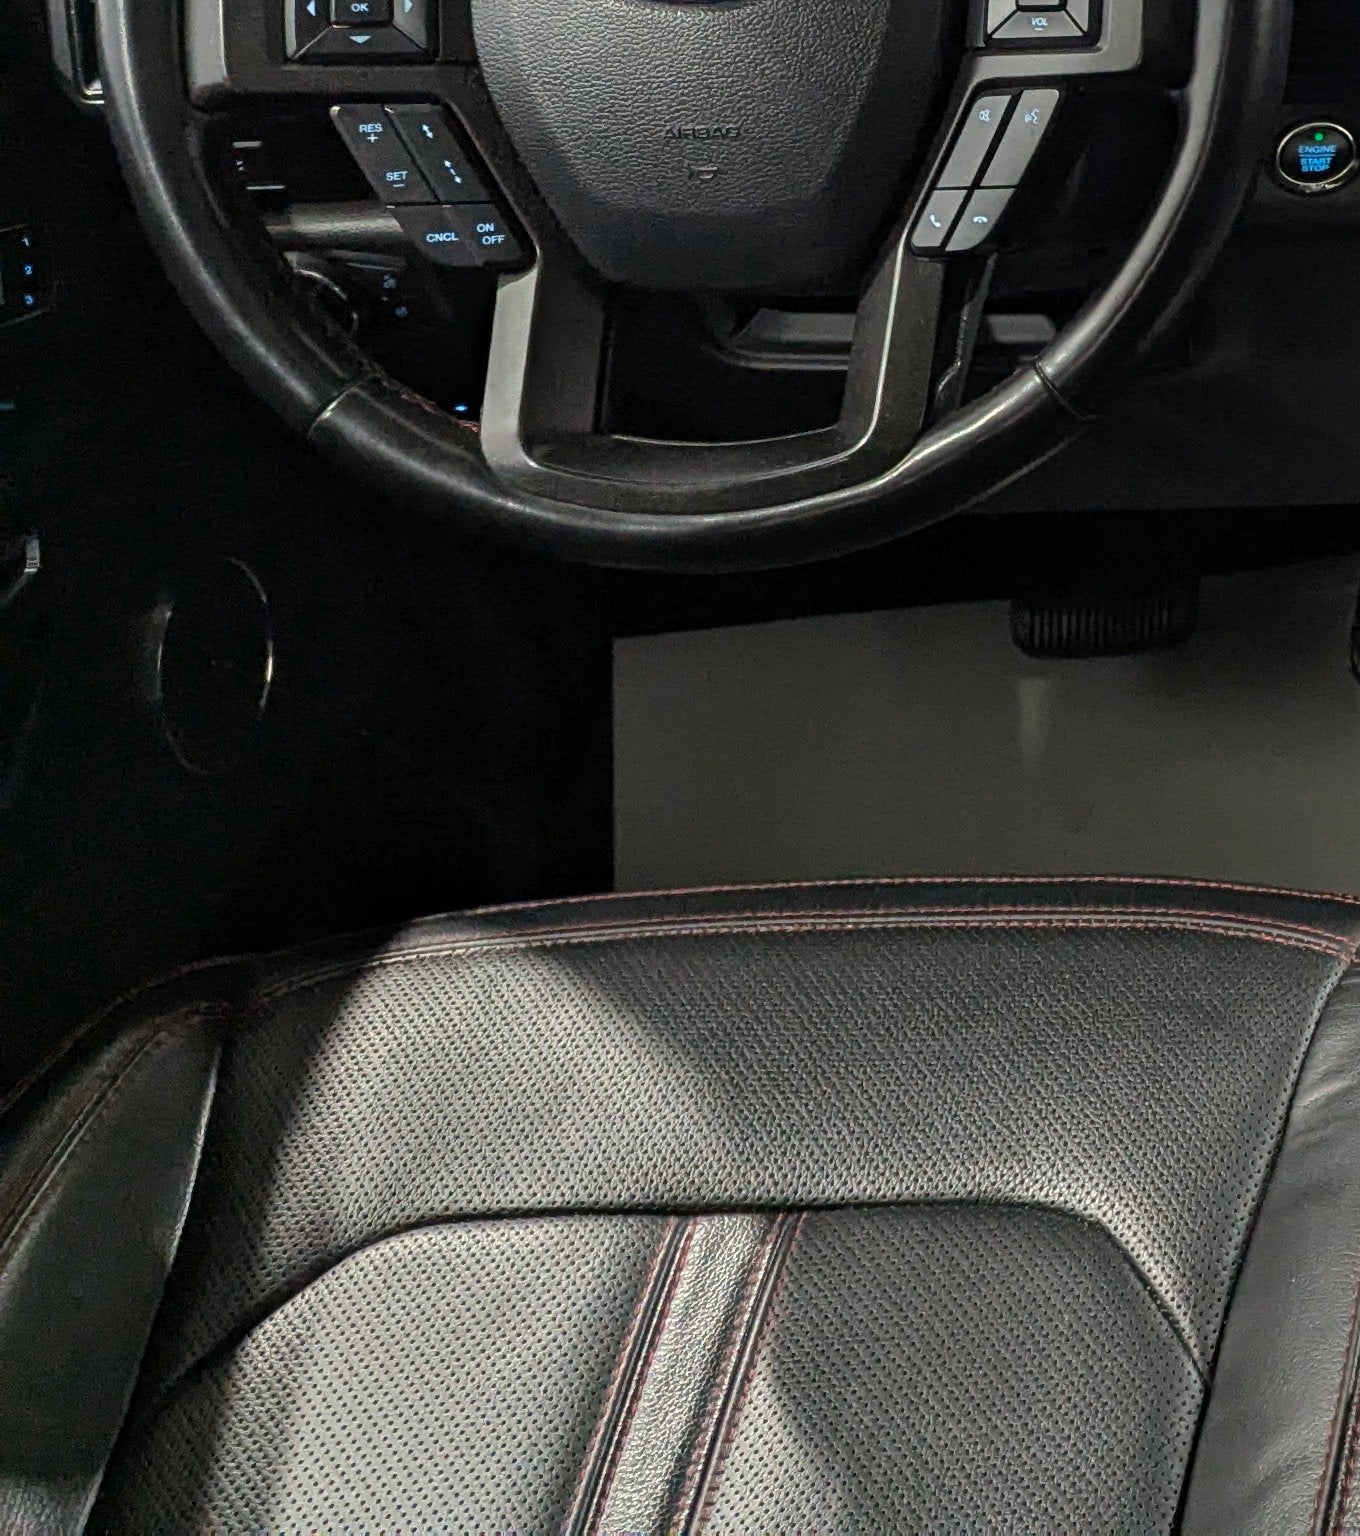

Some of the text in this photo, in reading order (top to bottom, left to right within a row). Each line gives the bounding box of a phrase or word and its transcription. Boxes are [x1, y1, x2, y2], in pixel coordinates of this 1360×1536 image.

[351, 2, 369, 12] OK
[1031, 17, 1048, 26] VOL
[359, 123, 383, 133] RES
[663, 125, 739, 140] AIRBAG
[1298, 145, 1336, 153] ENGINE
[1301, 157, 1332, 165] START
[1302, 164, 1330, 172] STOP
[386, 171, 408, 181] SET
[476, 223, 494, 233] ON
[22, 237, 30, 246] 1
[426, 232, 459, 243] CNCL
[481, 234, 505, 245] OFF
[24, 265, 33, 275] 2
